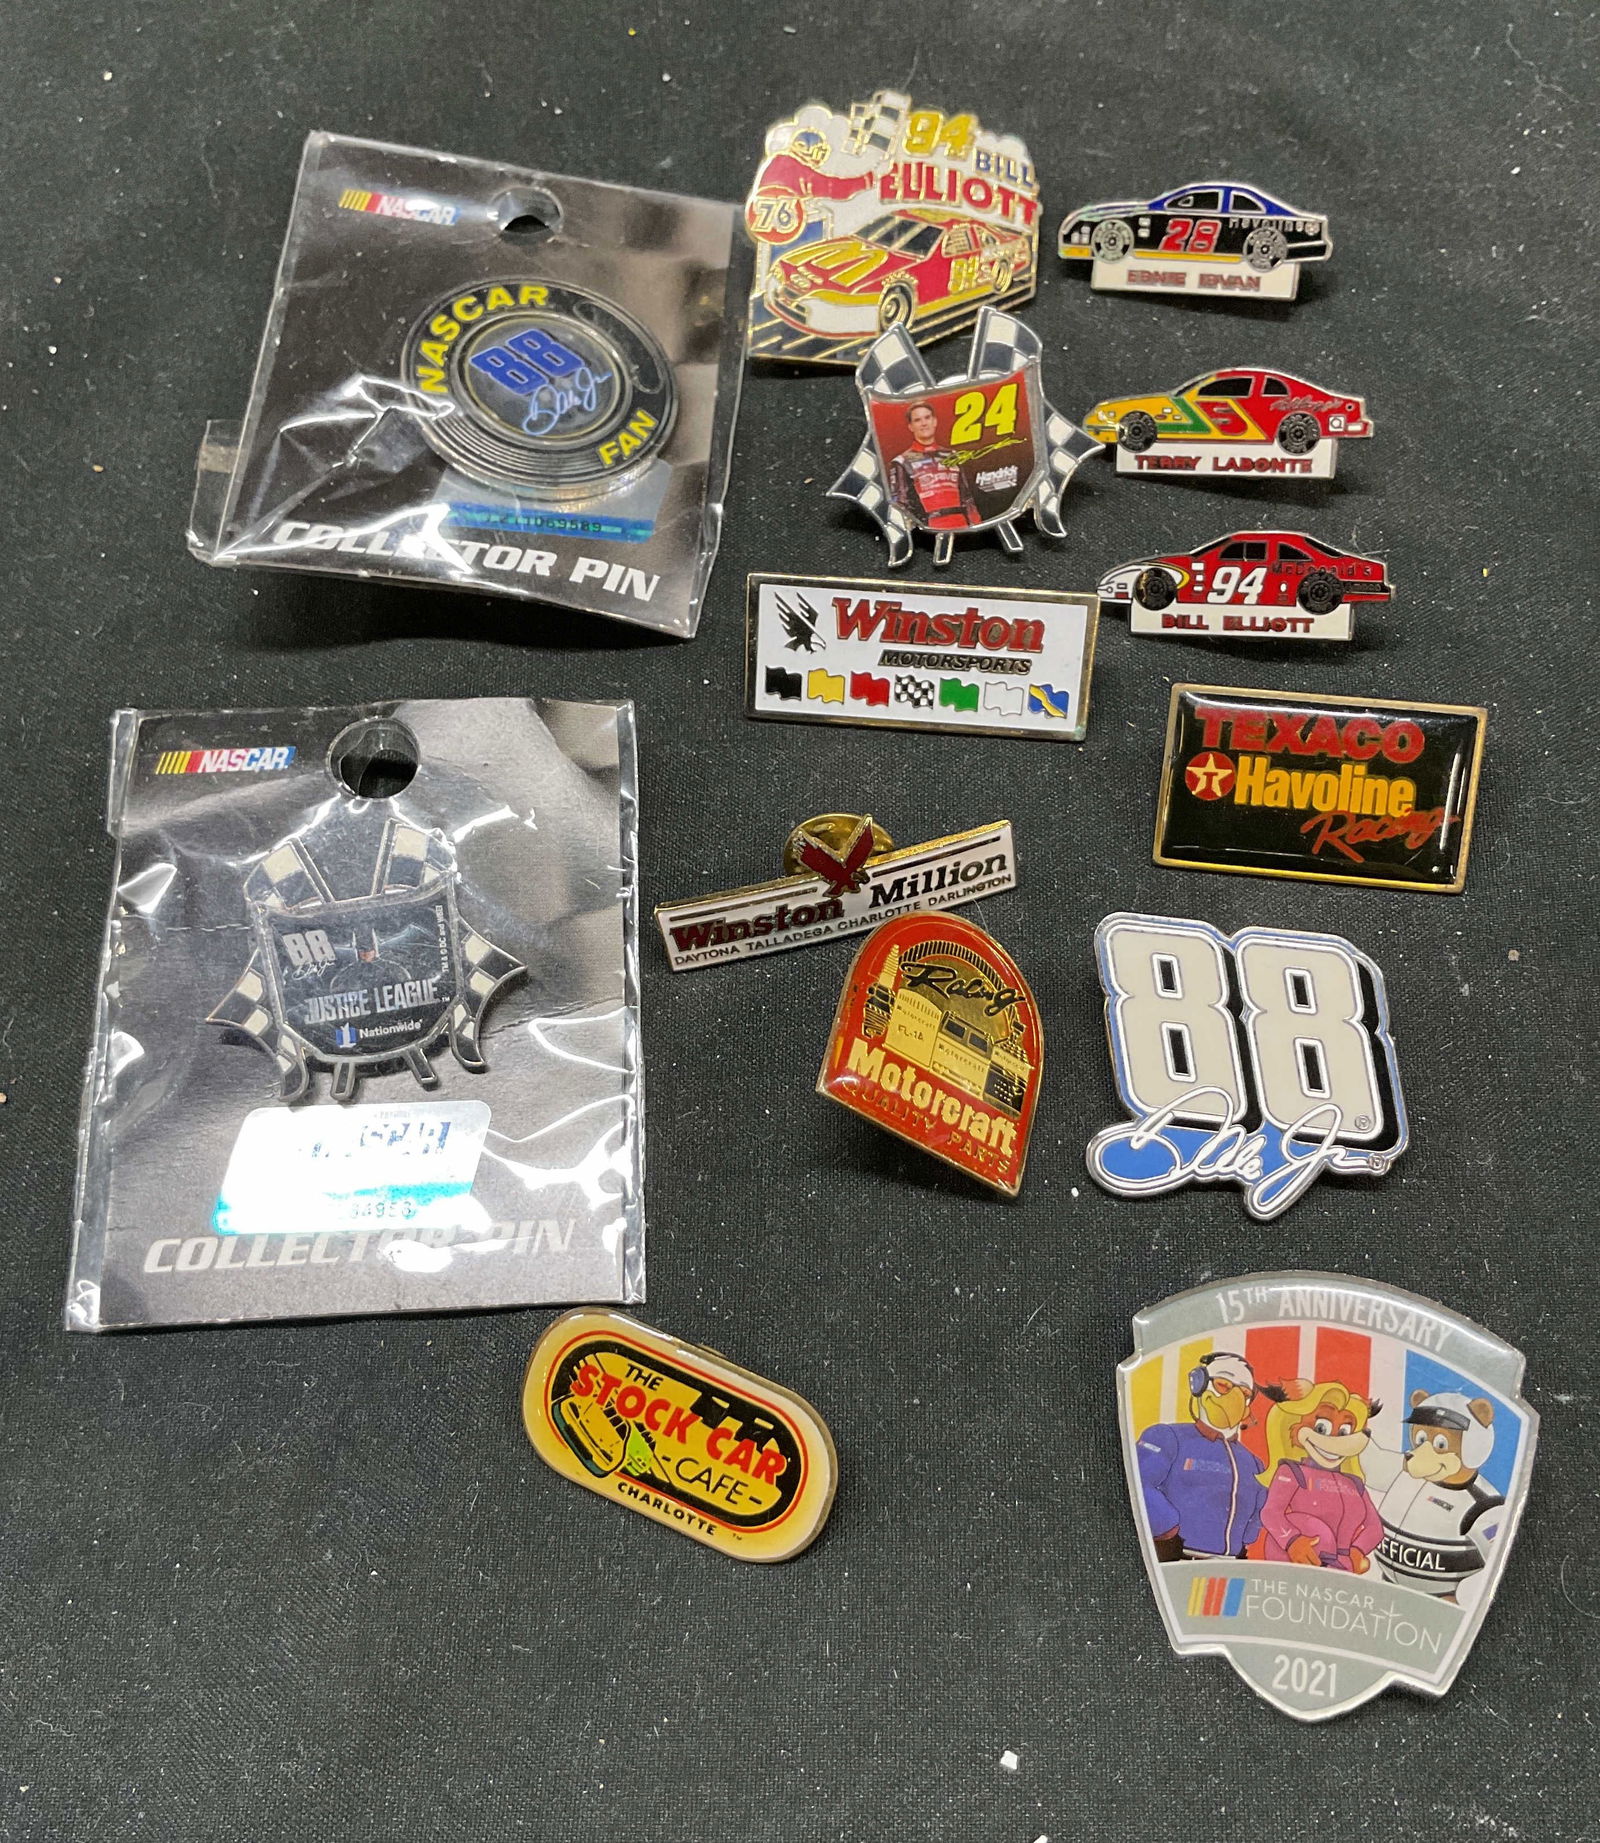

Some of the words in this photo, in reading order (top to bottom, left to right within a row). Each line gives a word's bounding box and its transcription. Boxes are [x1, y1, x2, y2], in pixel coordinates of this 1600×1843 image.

[904, 110, 977, 160] 94
[879, 162, 1039, 226] ELLIOTT
[974, 149, 1035, 188] BILL
[751, 198, 798, 232] 76
[1160, 218, 1221, 253] 28
[416, 284, 549, 394] NASCAR
[470, 328, 585, 396] 88
[598, 408, 658, 468] FAN
[950, 383, 1018, 446] 24
[1135, 455, 1201, 471] TERRY
[1212, 455, 1313, 473] LABONTE
[273, 520, 558, 577] COLLTOR
[568, 557, 660, 602] PIN
[1207, 566, 1268, 605] 94
[832, 597, 1045, 653] Winston
[1162, 613, 1209, 631] BILL
[1223, 615, 1314, 633] ELLIOTT
[877, 649, 1032, 675] MOTORSPORTS
[198, 746, 289, 773] NASCAR
[1195, 706, 1425, 763] TEXACO
[1234, 754, 1417, 818] Havoline
[1301, 807, 1461, 864] Racing
[869, 853, 1008, 909] Million
[282, 929, 336, 966] 88
[669, 898, 846, 951] Winston
[675, 944, 741, 966] DAYTONA
[746, 925, 833, 951] TALLADEGA
[837, 900, 921, 930] CHARLOTTE
[928, 873, 1012, 907] DARLINGTON
[304, 989, 371, 1025] JUSTICE
[374, 977, 440, 1014] LEAGUE
[900, 962, 1026, 1016] Racing
[359, 1020, 422, 1039] Nationwide
[1104, 922, 1385, 1141] 88
[847, 1038, 1017, 1157] Motorcraft
[842, 1080, 937, 1134] QUALITY
[947, 1130, 1011, 1174] PARTS
[1278, 1286, 1451, 1353] ANNIVERSARY
[624, 1362, 664, 1392] THE
[570, 1364, 703, 1445] STOCK
[705, 1427, 788, 1486] CAR
[617, 1480, 717, 1537] CHARLOTTE
[1377, 1536, 1447, 1571] FFICIAL
[1251, 1577, 1288, 1596] THE
[1296, 1583, 1375, 1611] NASCAR
[1245, 1594, 1444, 1656] FOUNDATION
[1272, 1653, 1338, 1699] 2021
